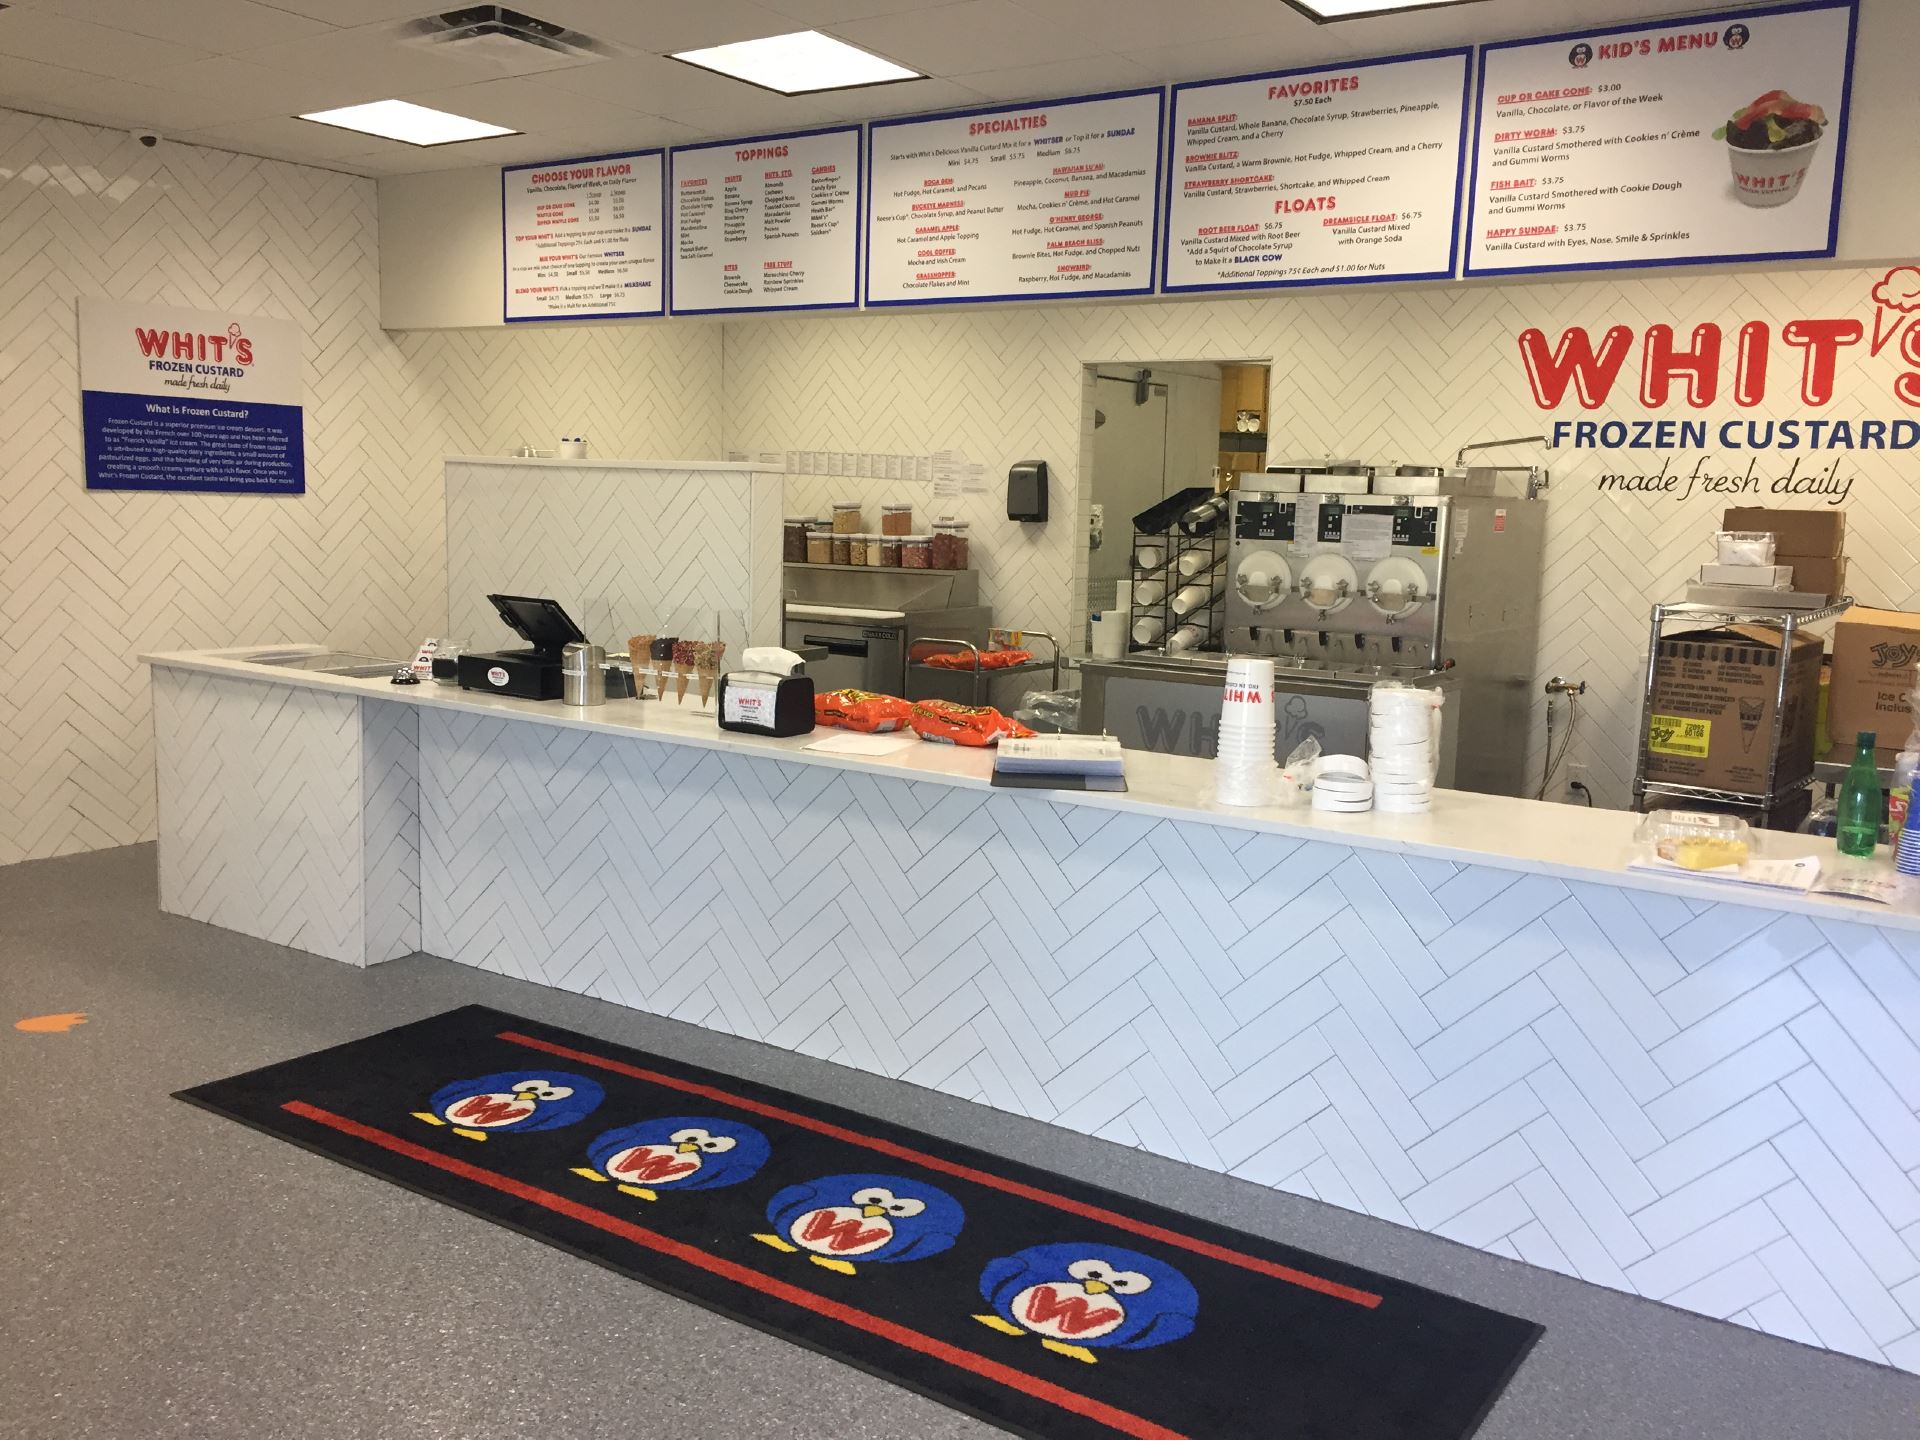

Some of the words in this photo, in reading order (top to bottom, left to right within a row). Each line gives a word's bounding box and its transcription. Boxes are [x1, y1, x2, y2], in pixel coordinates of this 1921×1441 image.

[1599, 39, 1651, 60] KID'S
[1658, 32, 1718, 54] MENU
[1268, 77, 1359, 100] FAVORITES
[1498, 94, 1517, 106] CUP
[1534, 90, 1561, 102] CAKE
[1562, 86, 1594, 99] CONE:
[1598, 83, 1622, 94] $3.00
[1294, 99, 1314, 108] $7.50
[1315, 96, 1332, 105] Each
[1497, 107, 1525, 120] Vanilla,
[1528, 103, 1572, 117] Chocolate,
[1584, 99, 1610, 110] Flavor
[1622, 96, 1637, 106] the
[1639, 94, 1663, 105] Week
[969, 115, 1047, 136] SPECIALTIES
[1187, 127, 1209, 137] Vanilla
[1210, 124, 1238, 136] Custard,
[1238, 121, 1260, 131] Whole
[1261, 118, 1290, 130] Banana,
[1289, 114, 1325, 126] Chocolate
[1327, 112, 1350, 124] Syrup,
[1351, 107, 1400, 121] Strawberries,
[1400, 103, 1440, 116] Pineapple,
[1188, 116, 1217, 127] BANANA
[1216, 114, 1239, 124] SPLIT:
[1187, 136, 1216, 148] Whipped
[1217, 133, 1241, 145] Cream,
[1241, 132, 1255, 141] and
[1261, 129, 1284, 141] Cherry
[1494, 145, 1520, 156] Vanilla
[1522, 142, 1554, 153] Custard
[1556, 138, 1602, 150] Smothered
[1604, 136, 1623, 146] with
[1625, 133, 1659, 145] Cookies
[1670, 129, 1700, 141] Crème
[1495, 131, 1522, 143] DIRTY
[1524, 128, 1559, 140] WORM:
[1563, 125, 1585, 136] $3.75
[736, 145, 789, 162] TOPPINGS
[1185, 153, 1218, 164] BROWNIE
[1218, 151, 1241, 161] BLITZ:
[1492, 157, 1508, 167] and
[1509, 154, 1539, 165] Gummi
[1541, 152, 1570, 163] Worms
[532, 171, 568, 184] CHOOSE
[570, 168, 594, 180] YOUR
[596, 164, 631, 177] FLAVOR
[1184, 178, 1230, 190] STRAWBERRY
[1229, 174, 1276, 186] SHORTCAKE:
[1734, 167, 1806, 189] WHIT'S
[1491, 180, 1511, 191] FISH
[1513, 178, 1538, 189] BAIT:
[1542, 176, 1564, 186] $3.75
[1490, 193, 1516, 204] Vanilla
[1518, 191, 1550, 202] Custard
[1552, 187, 1598, 200] Smothered
[1599, 186, 1619, 196] with
[1620, 184, 1650, 195] Cookie
[1652, 182, 1683, 195] Dough
[1275, 196, 1336, 214] FLOATS
[1489, 205, 1504, 215] and
[1505, 203, 1535, 214] Gummi
[1537, 201, 1566, 212] Worms
[1323, 216, 1371, 228] DREAMSICLE
[1370, 214, 1399, 224] FLOAT:
[1402, 212, 1422, 221] $6.75
[1332, 226, 1357, 235] Vanilla
[1358, 225, 1386, 234] Custard
[1388, 223, 1411, 232] Mixed
[1198, 227, 1219, 237] ROOT
[1218, 226, 1237, 235] BEER
[1236, 224, 1262, 234] FLOAT:
[1265, 222, 1283, 231] $6.75
[1487, 227, 1517, 239] HAPPY
[1518, 224, 1560, 236] SUNDAE:
[1564, 222, 1586, 233] $3.75
[1338, 237, 1354, 246] with
[1355, 235, 1383, 246] Orange
[1384, 234, 1403, 243] Soda
[1486, 241, 1512, 251] Vanilla
[1514, 239, 1546, 249] Custard
[1548, 238, 1565, 248] with
[1616, 234, 1639, 244] Smile
[1650, 231, 1690, 244] Sprinkles
[1204, 257, 1221, 266] Make
[1234, 255, 1260, 265] BLACK
[1262, 253, 1283, 263] COW
[135, 323, 253, 366] WHIT'S
[149, 360, 193, 373] FROZEN
[195, 364, 244, 378] CUSTARD
[164, 375, 187, 387] made
[187, 376, 208, 390] fresh
[210, 377, 230, 393] daily
[146, 404, 171, 414] What
[182, 406, 210, 416] Frozen
[212, 408, 249, 419] Custard?
[1552, 421, 1706, 450] FROZEN
[1719, 420, 1921, 450] CUSTARD
[1598, 457, 1679, 493] made
[1677, 456, 1760, 501] fresh
[1771, 457, 1855, 505] daily
[450, 1093, 533, 1125] W
[614, 1147, 699, 1182] W
[803, 1209, 889, 1250] W
[1025, 1285, 1120, 1333] W
